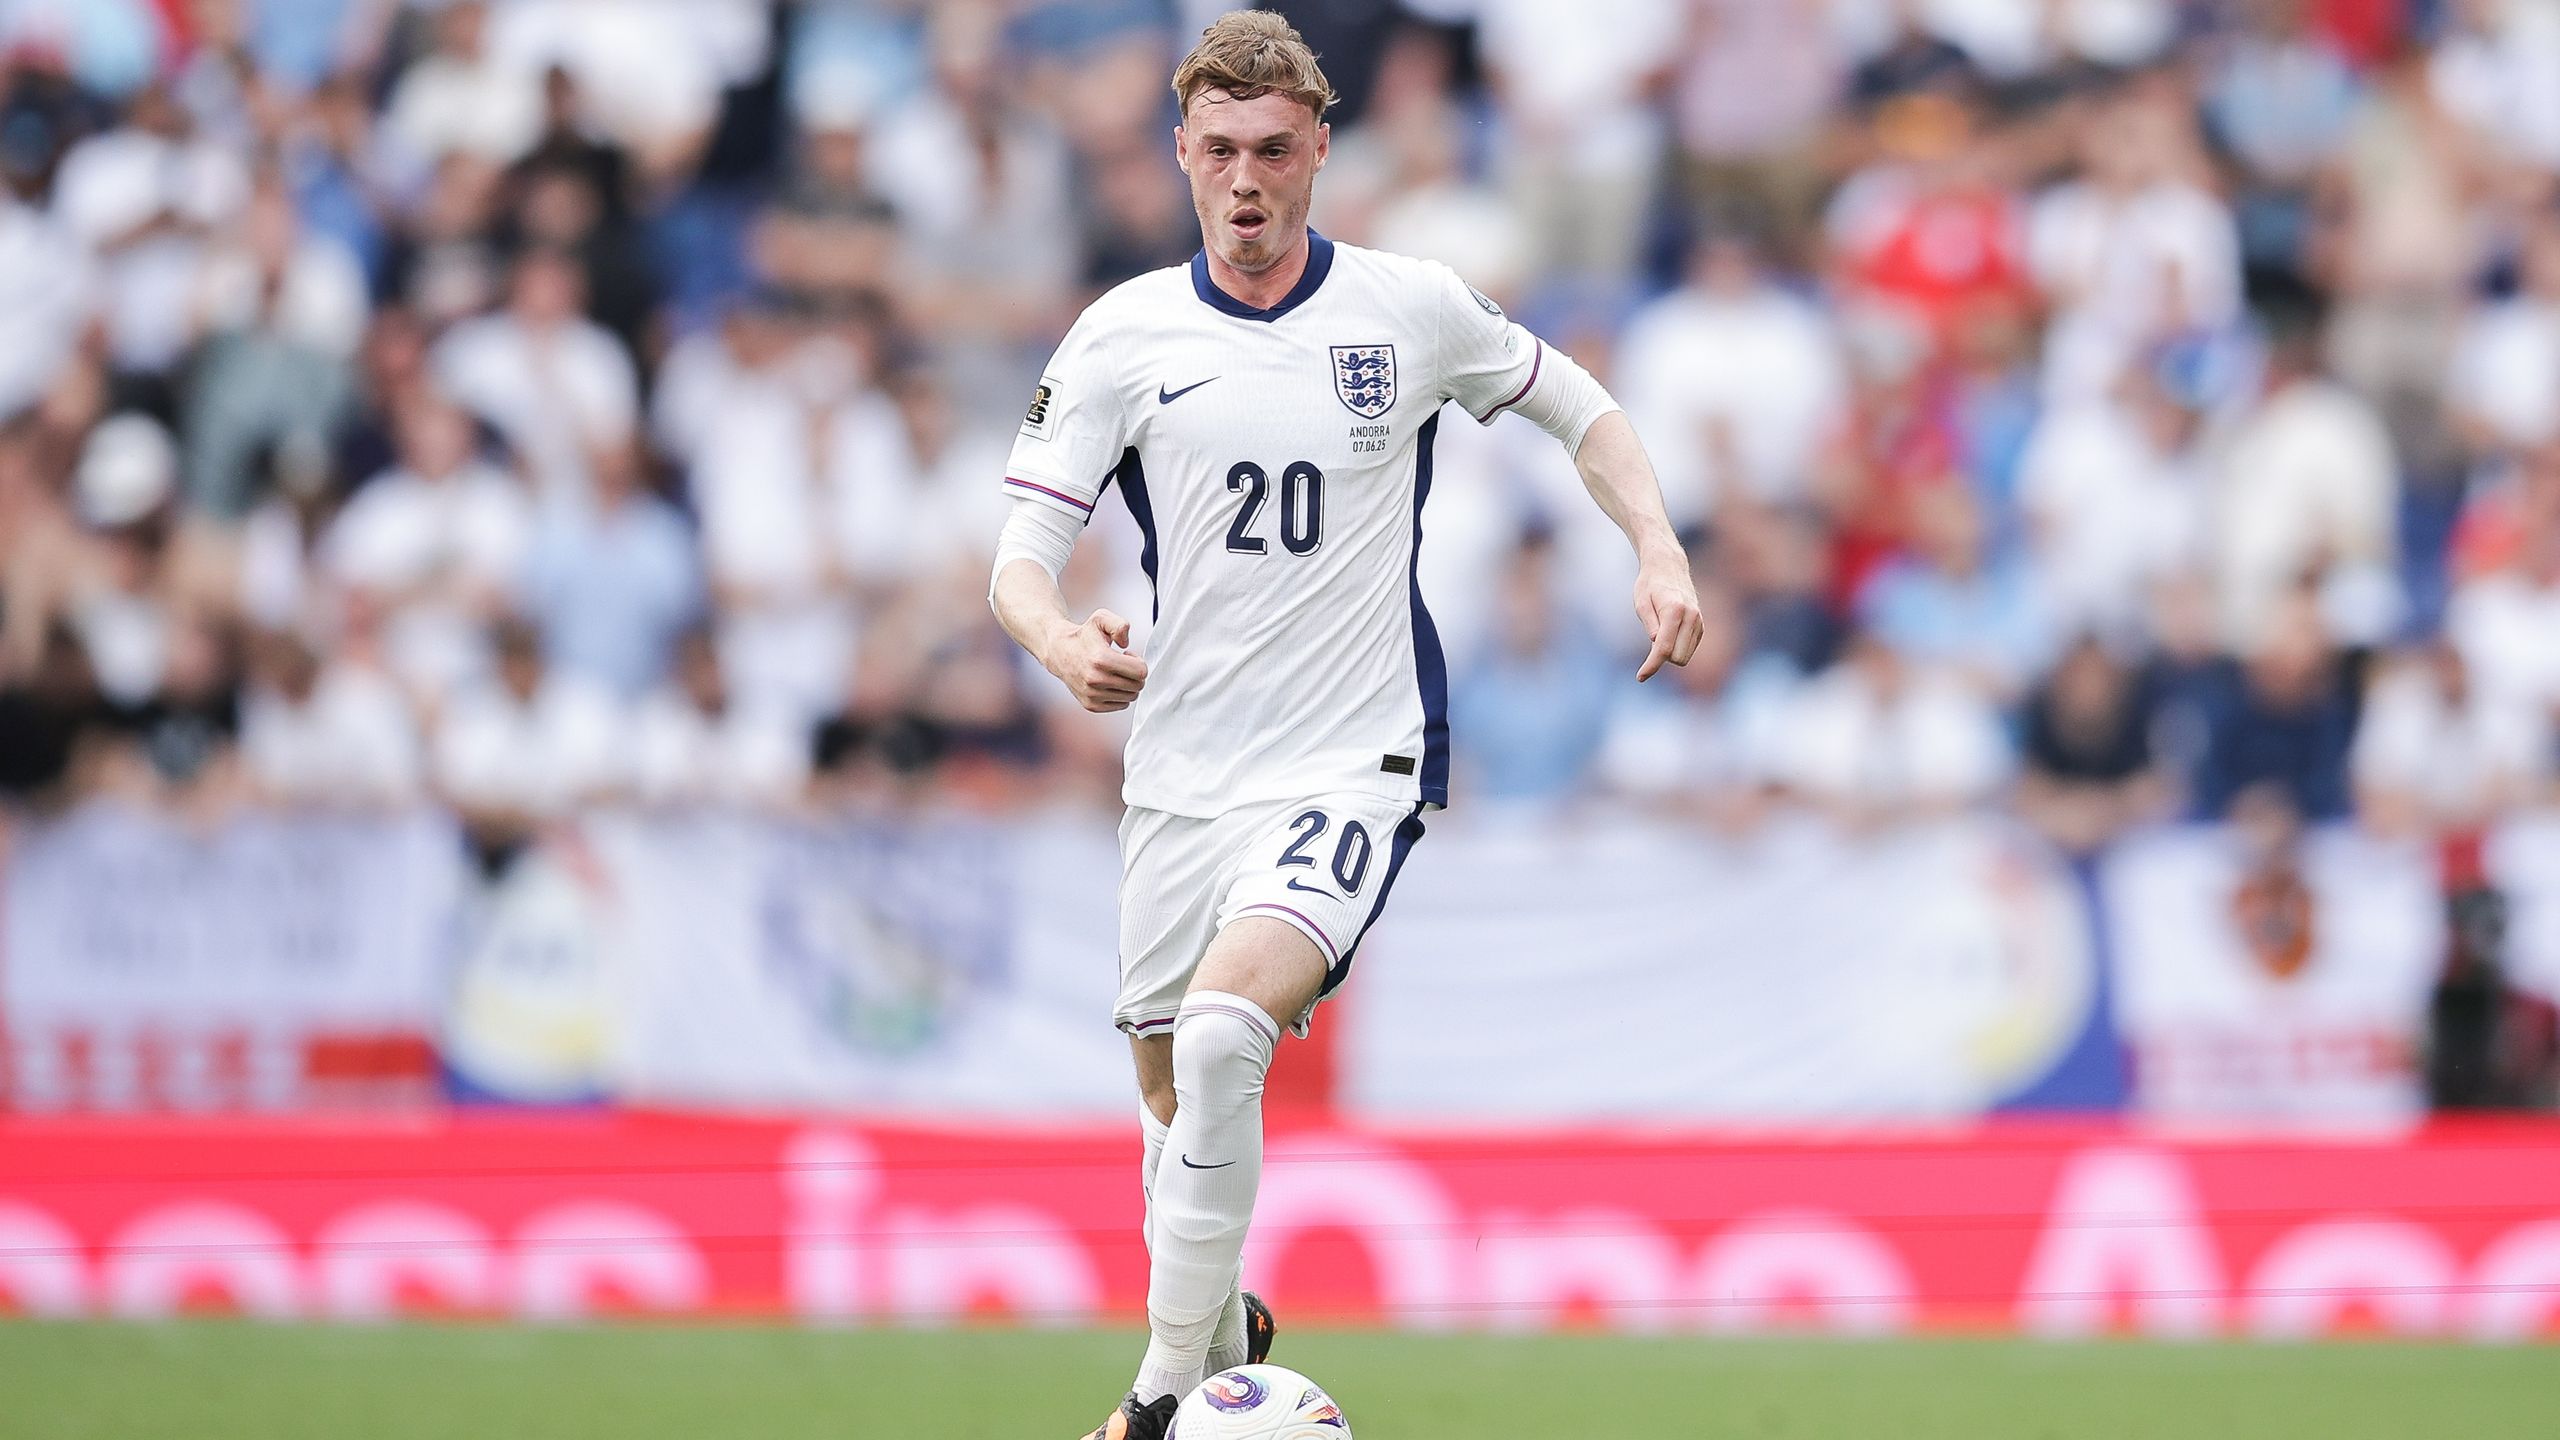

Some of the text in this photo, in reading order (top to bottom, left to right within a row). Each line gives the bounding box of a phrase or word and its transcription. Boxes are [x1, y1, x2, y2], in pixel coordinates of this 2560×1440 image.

[1349, 425, 1390, 438] ANDORRA
[1352, 439, 1386, 453] 07.06.25
[1226, 460, 1325, 557] 20
[1276, 810, 1373, 898] 20
[783, 1124, 1104, 1326] in
